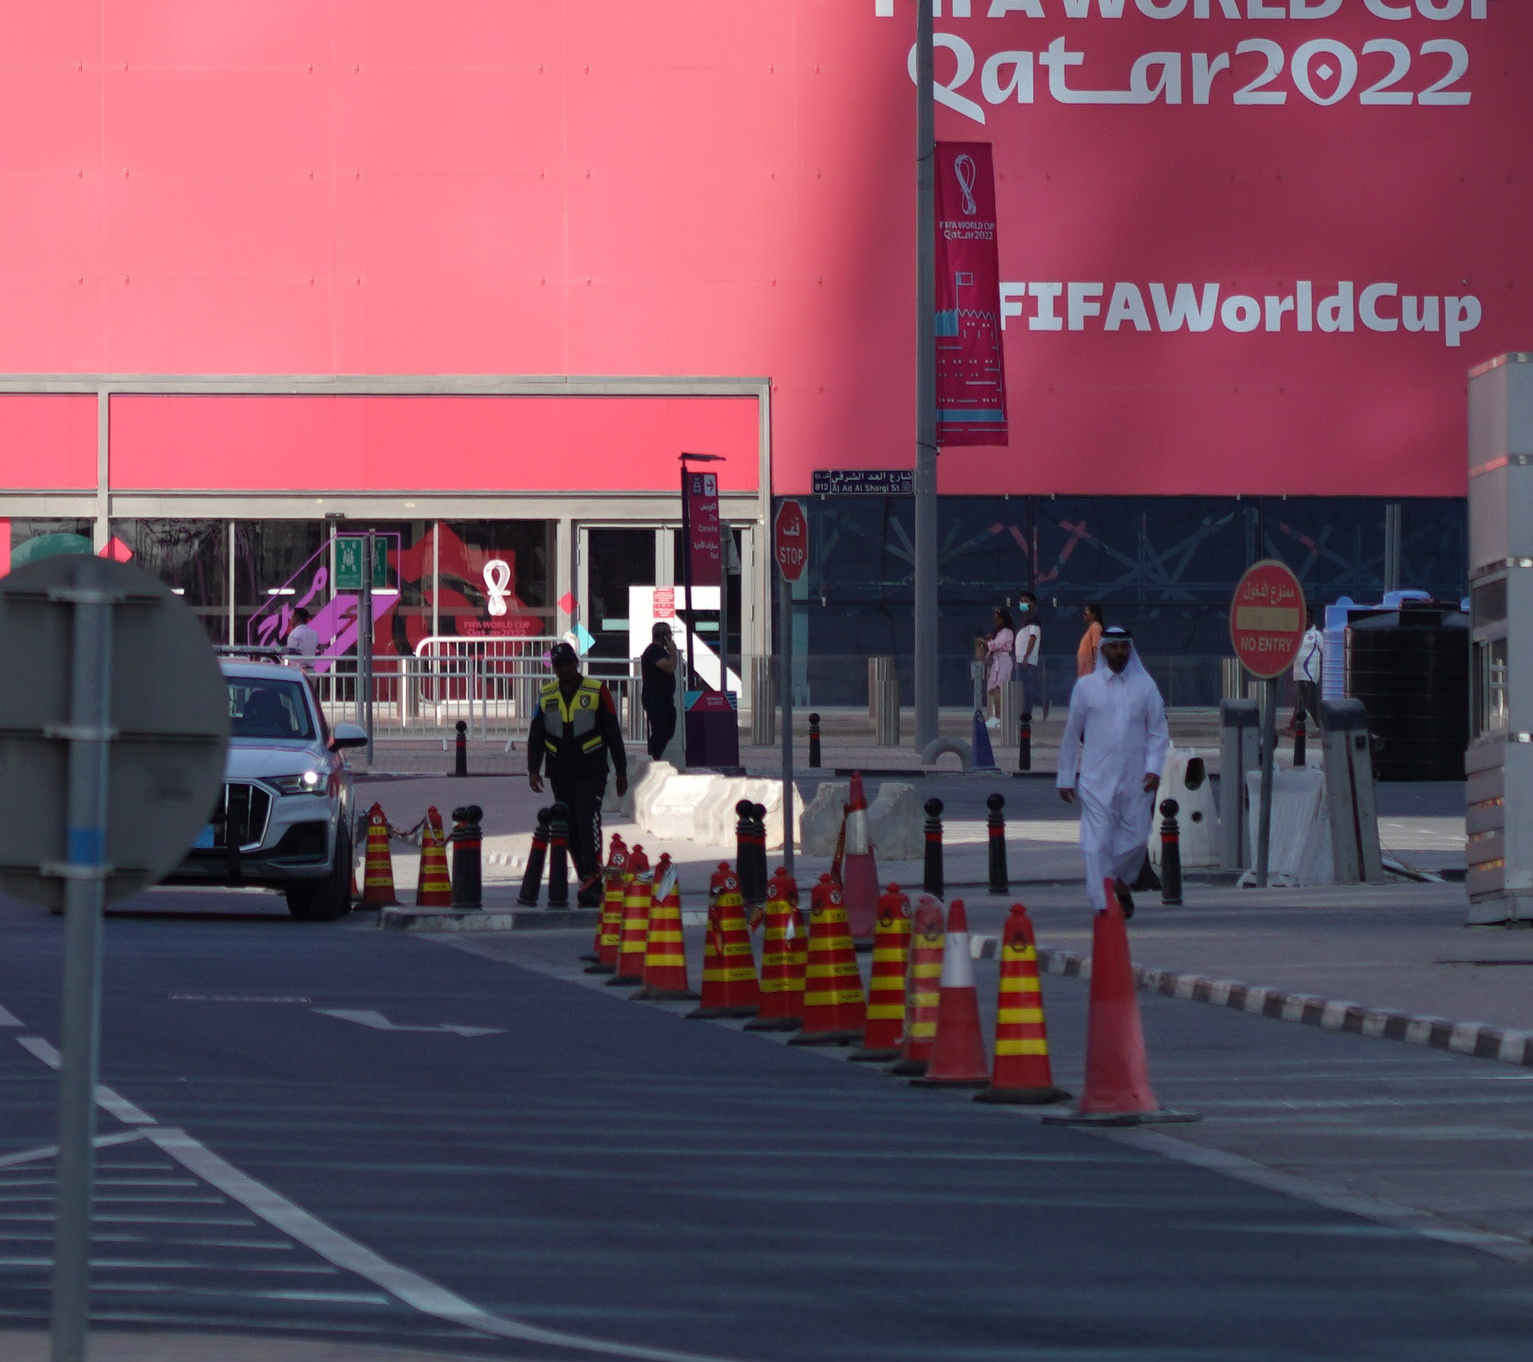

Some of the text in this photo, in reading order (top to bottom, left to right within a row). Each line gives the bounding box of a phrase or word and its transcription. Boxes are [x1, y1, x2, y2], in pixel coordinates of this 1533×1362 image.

[939, 221, 995, 230] FIFA WORLD CUP
[831, 472, 864, 483] الشرقي
[889, 472, 912, 483] شارع
[815, 483, 829, 491] 812
[832, 484, 840, 492] Al
[842, 484, 853, 493] Ad
[855, 484, 863, 492] Al
[783, 516, 801, 536] قف
[780, 547, 804, 565] STOP
[483, 621, 512, 629] WORLD
[514, 621, 531, 629] CUP
[1240, 637, 1293, 653] NO ENTRY
